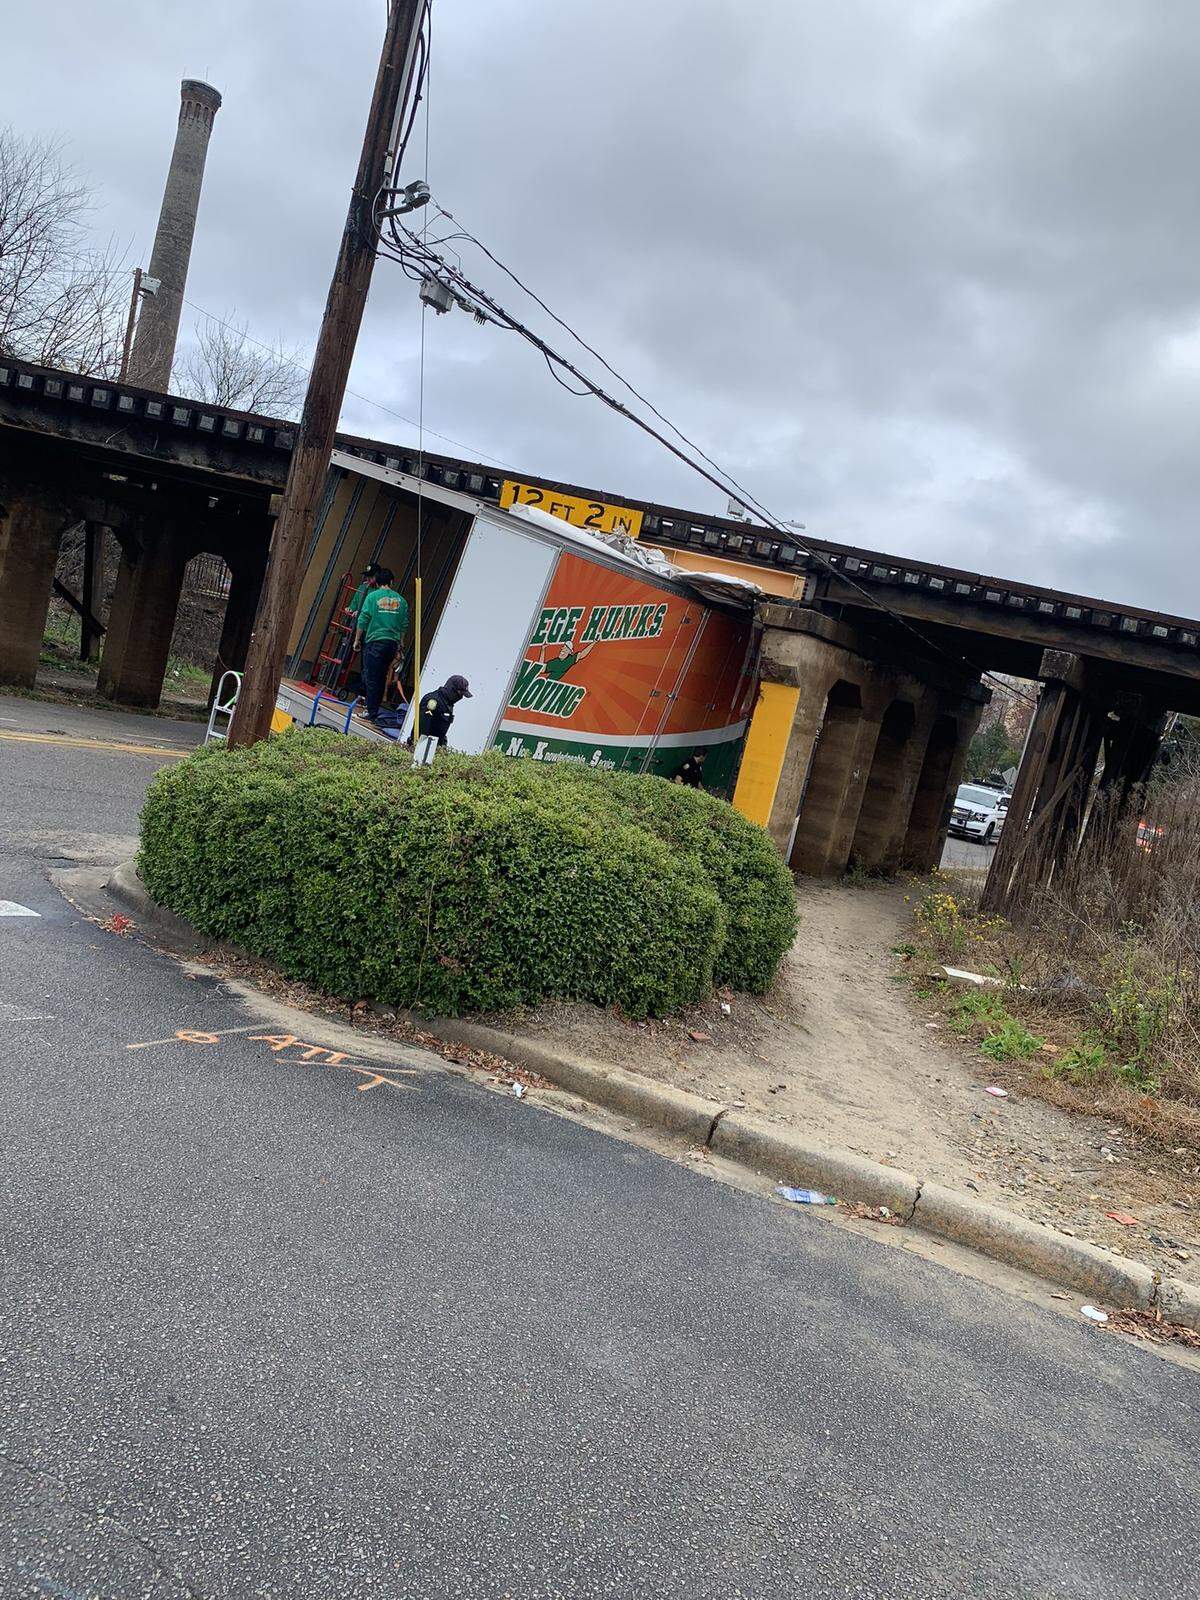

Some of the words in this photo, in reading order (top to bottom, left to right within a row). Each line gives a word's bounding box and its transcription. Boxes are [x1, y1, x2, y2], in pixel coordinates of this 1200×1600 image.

[512, 484, 544, 505] 12
[549, 501, 576, 522] FT
[583, 503, 606, 528] 2
[611, 515, 633, 534] IN
